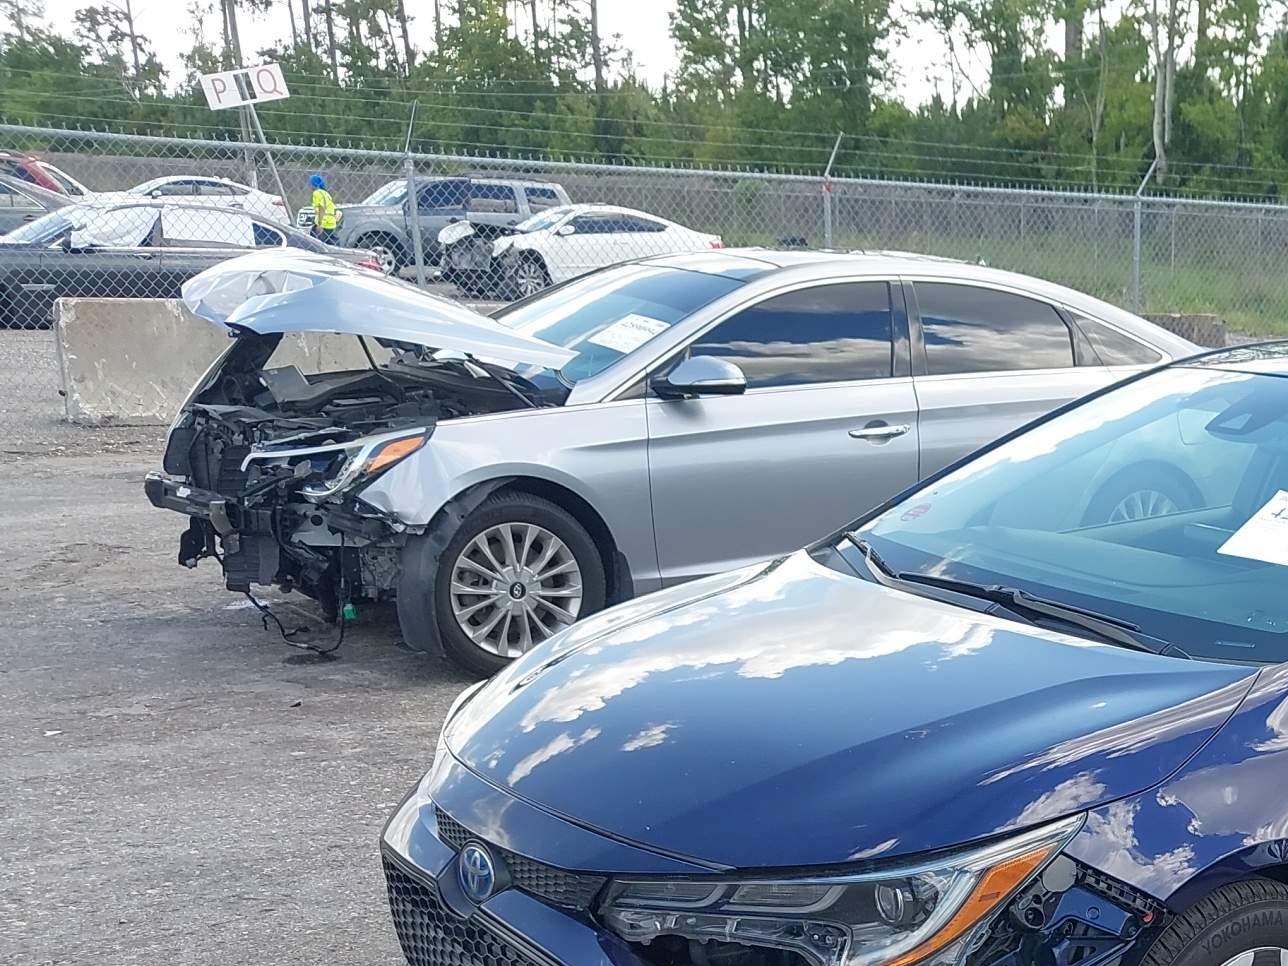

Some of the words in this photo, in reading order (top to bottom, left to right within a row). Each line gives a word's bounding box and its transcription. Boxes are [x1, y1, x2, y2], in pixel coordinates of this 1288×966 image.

[211, 78, 227, 104] P
[254, 68, 284, 96] Q
[1202, 910, 1283, 955] YOKOHAMA
